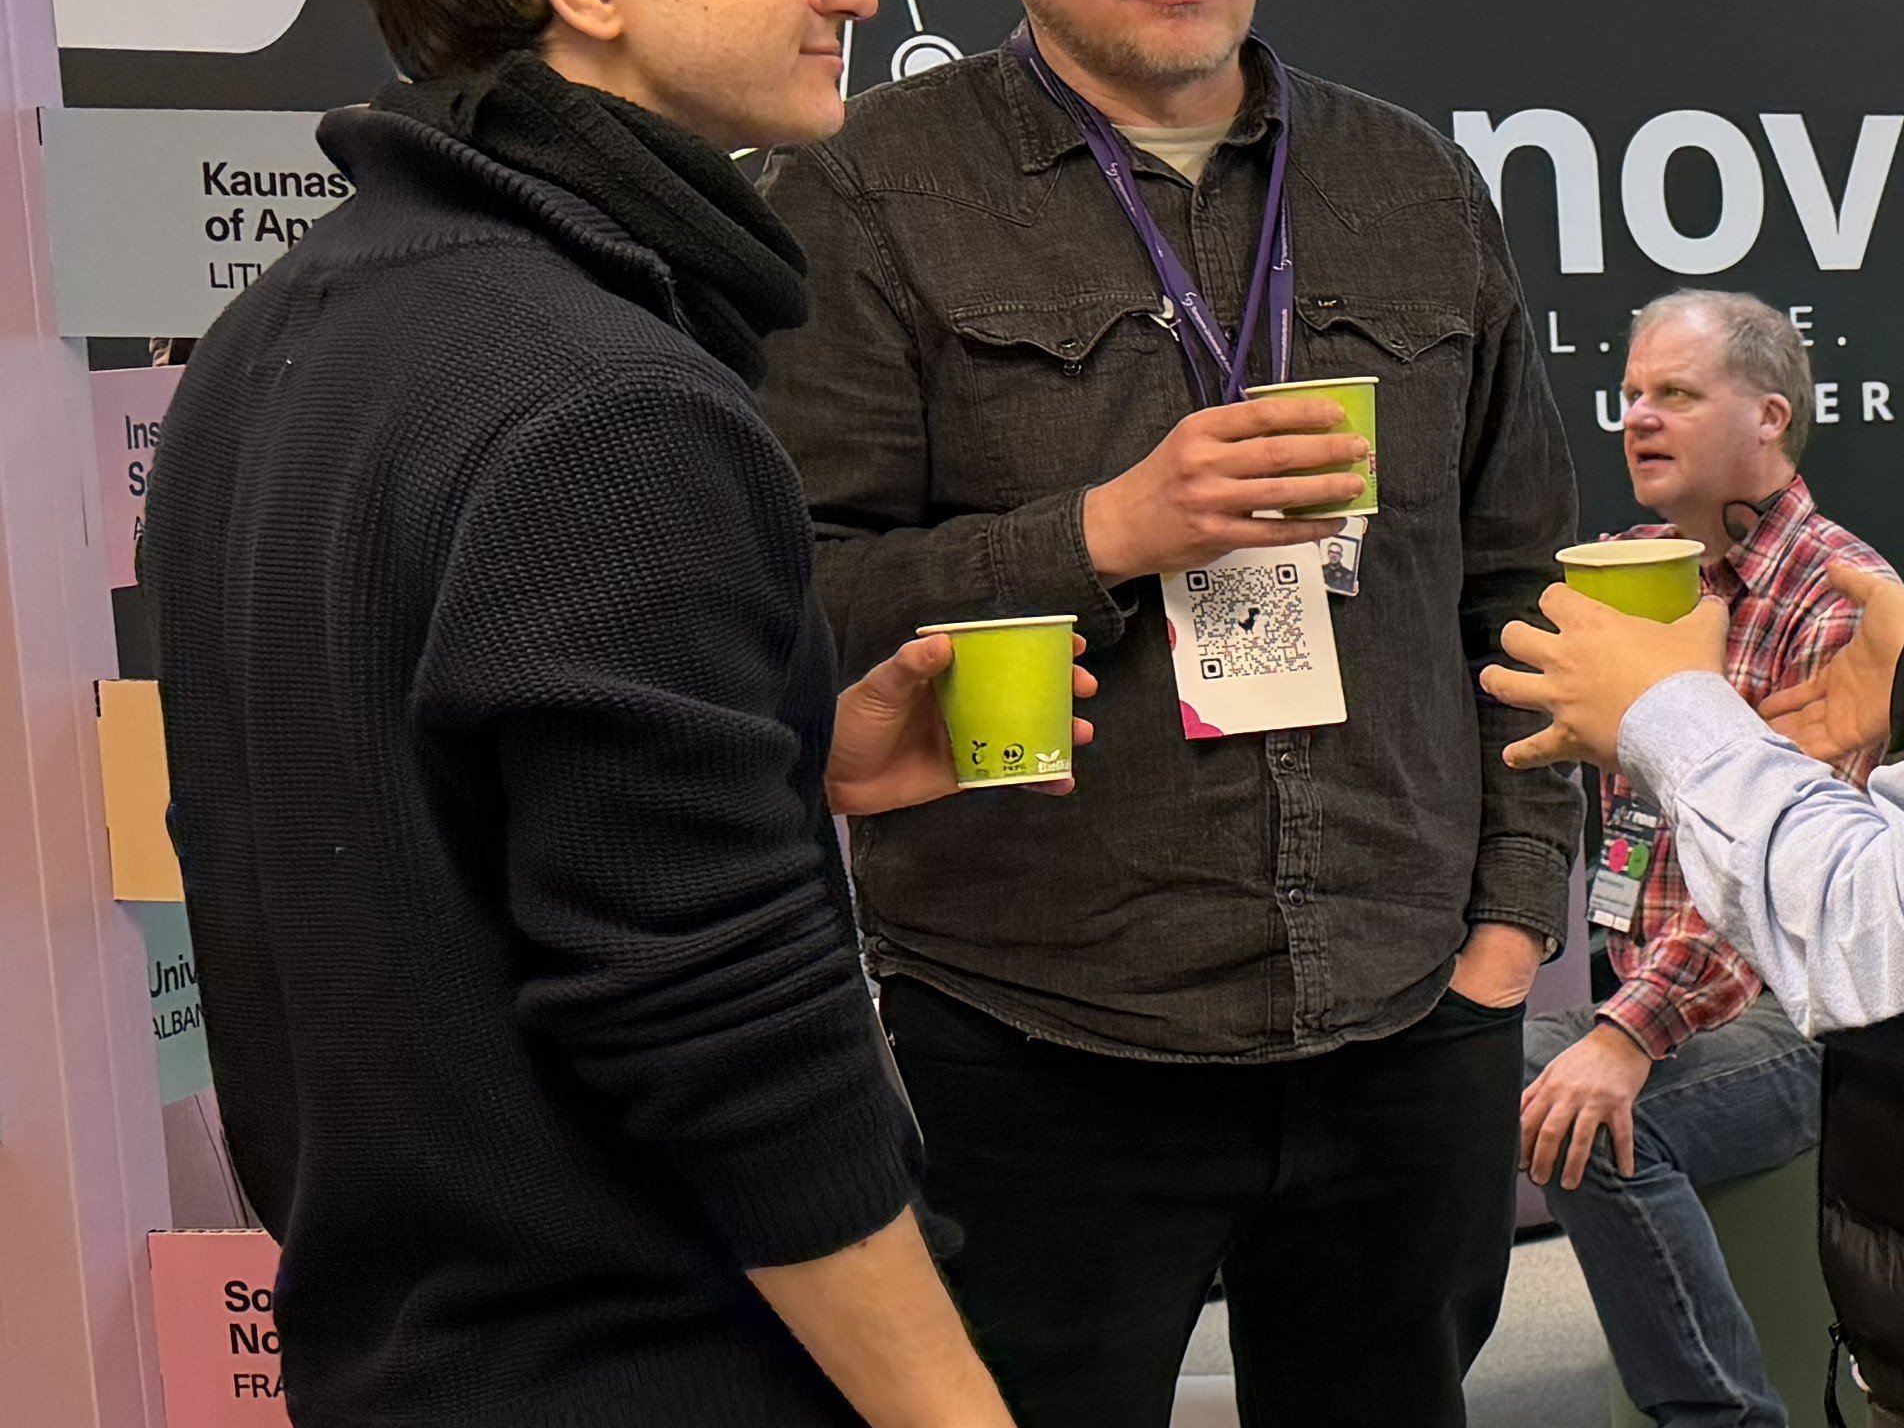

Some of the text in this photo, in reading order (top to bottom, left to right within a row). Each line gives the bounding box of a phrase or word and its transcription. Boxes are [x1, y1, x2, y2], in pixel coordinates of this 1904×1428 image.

[202, 161, 349, 198] Kaunas
[205, 208, 317, 251] of Ap
